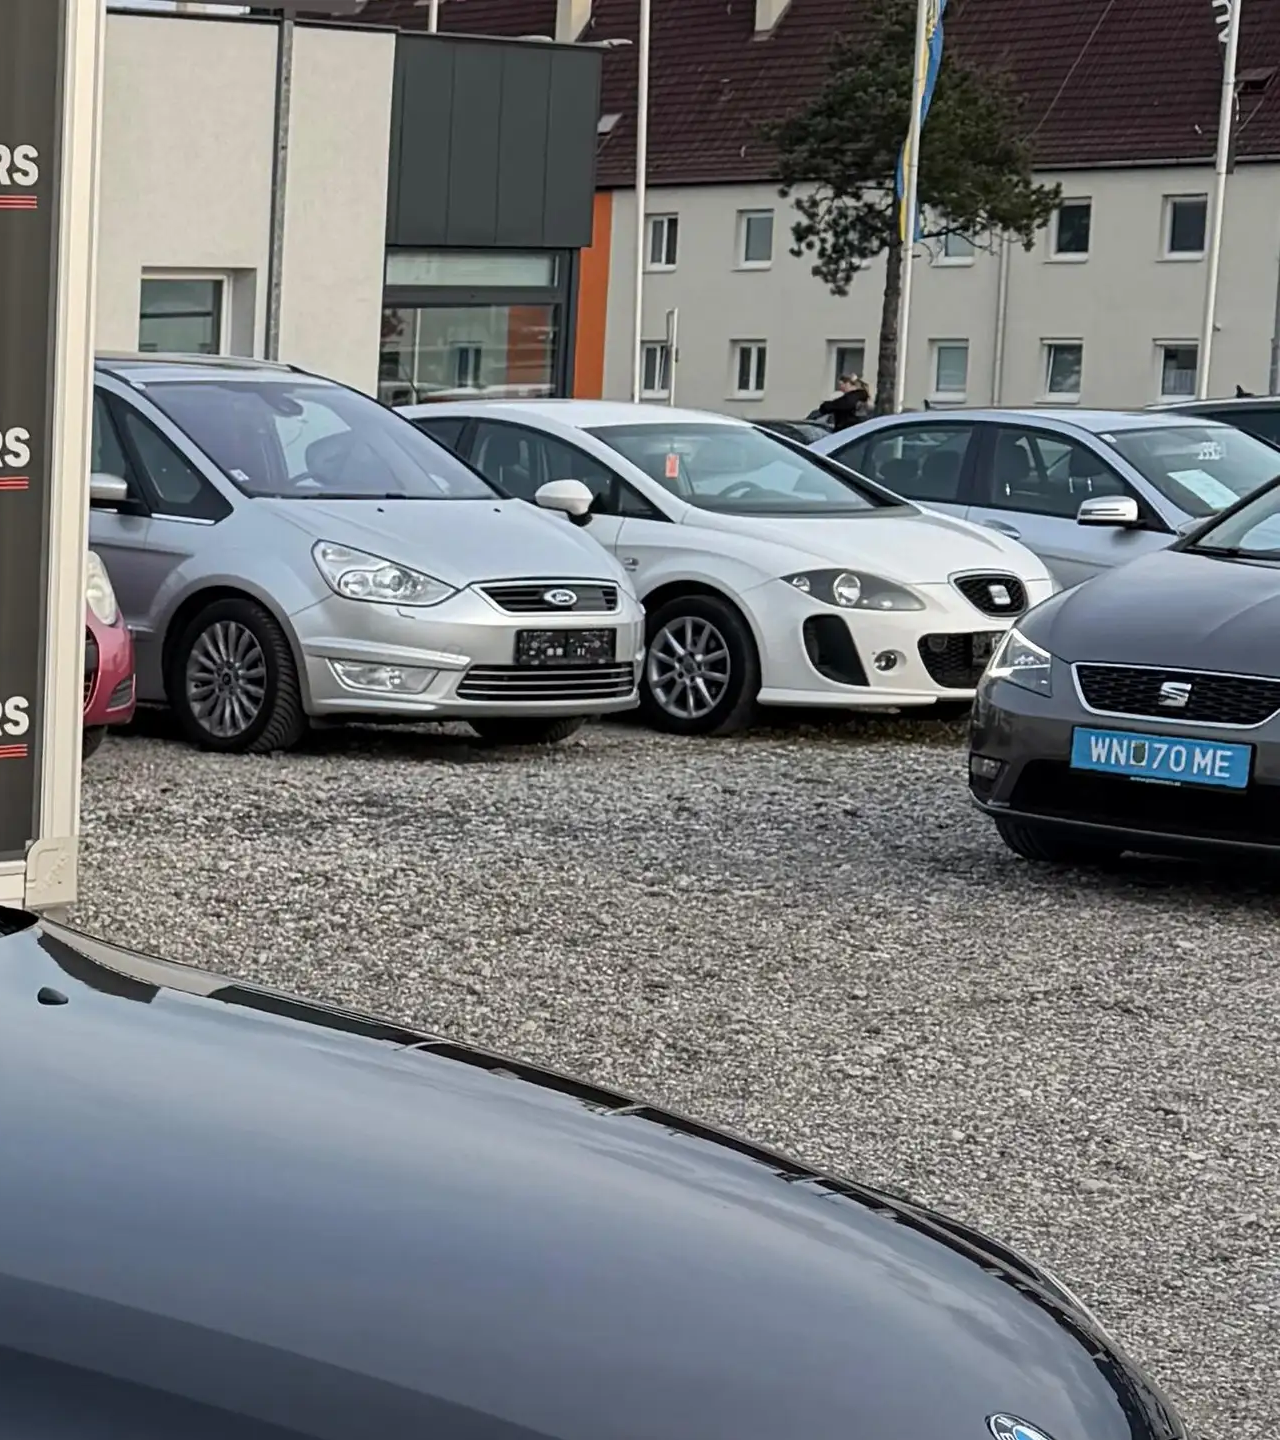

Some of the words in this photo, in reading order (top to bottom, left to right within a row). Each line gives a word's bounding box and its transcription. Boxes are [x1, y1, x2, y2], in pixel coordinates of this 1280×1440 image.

[1091, 735, 1128, 767] WN
[1152, 743, 1187, 773] 70
[1193, 748, 1234, 778] ME
